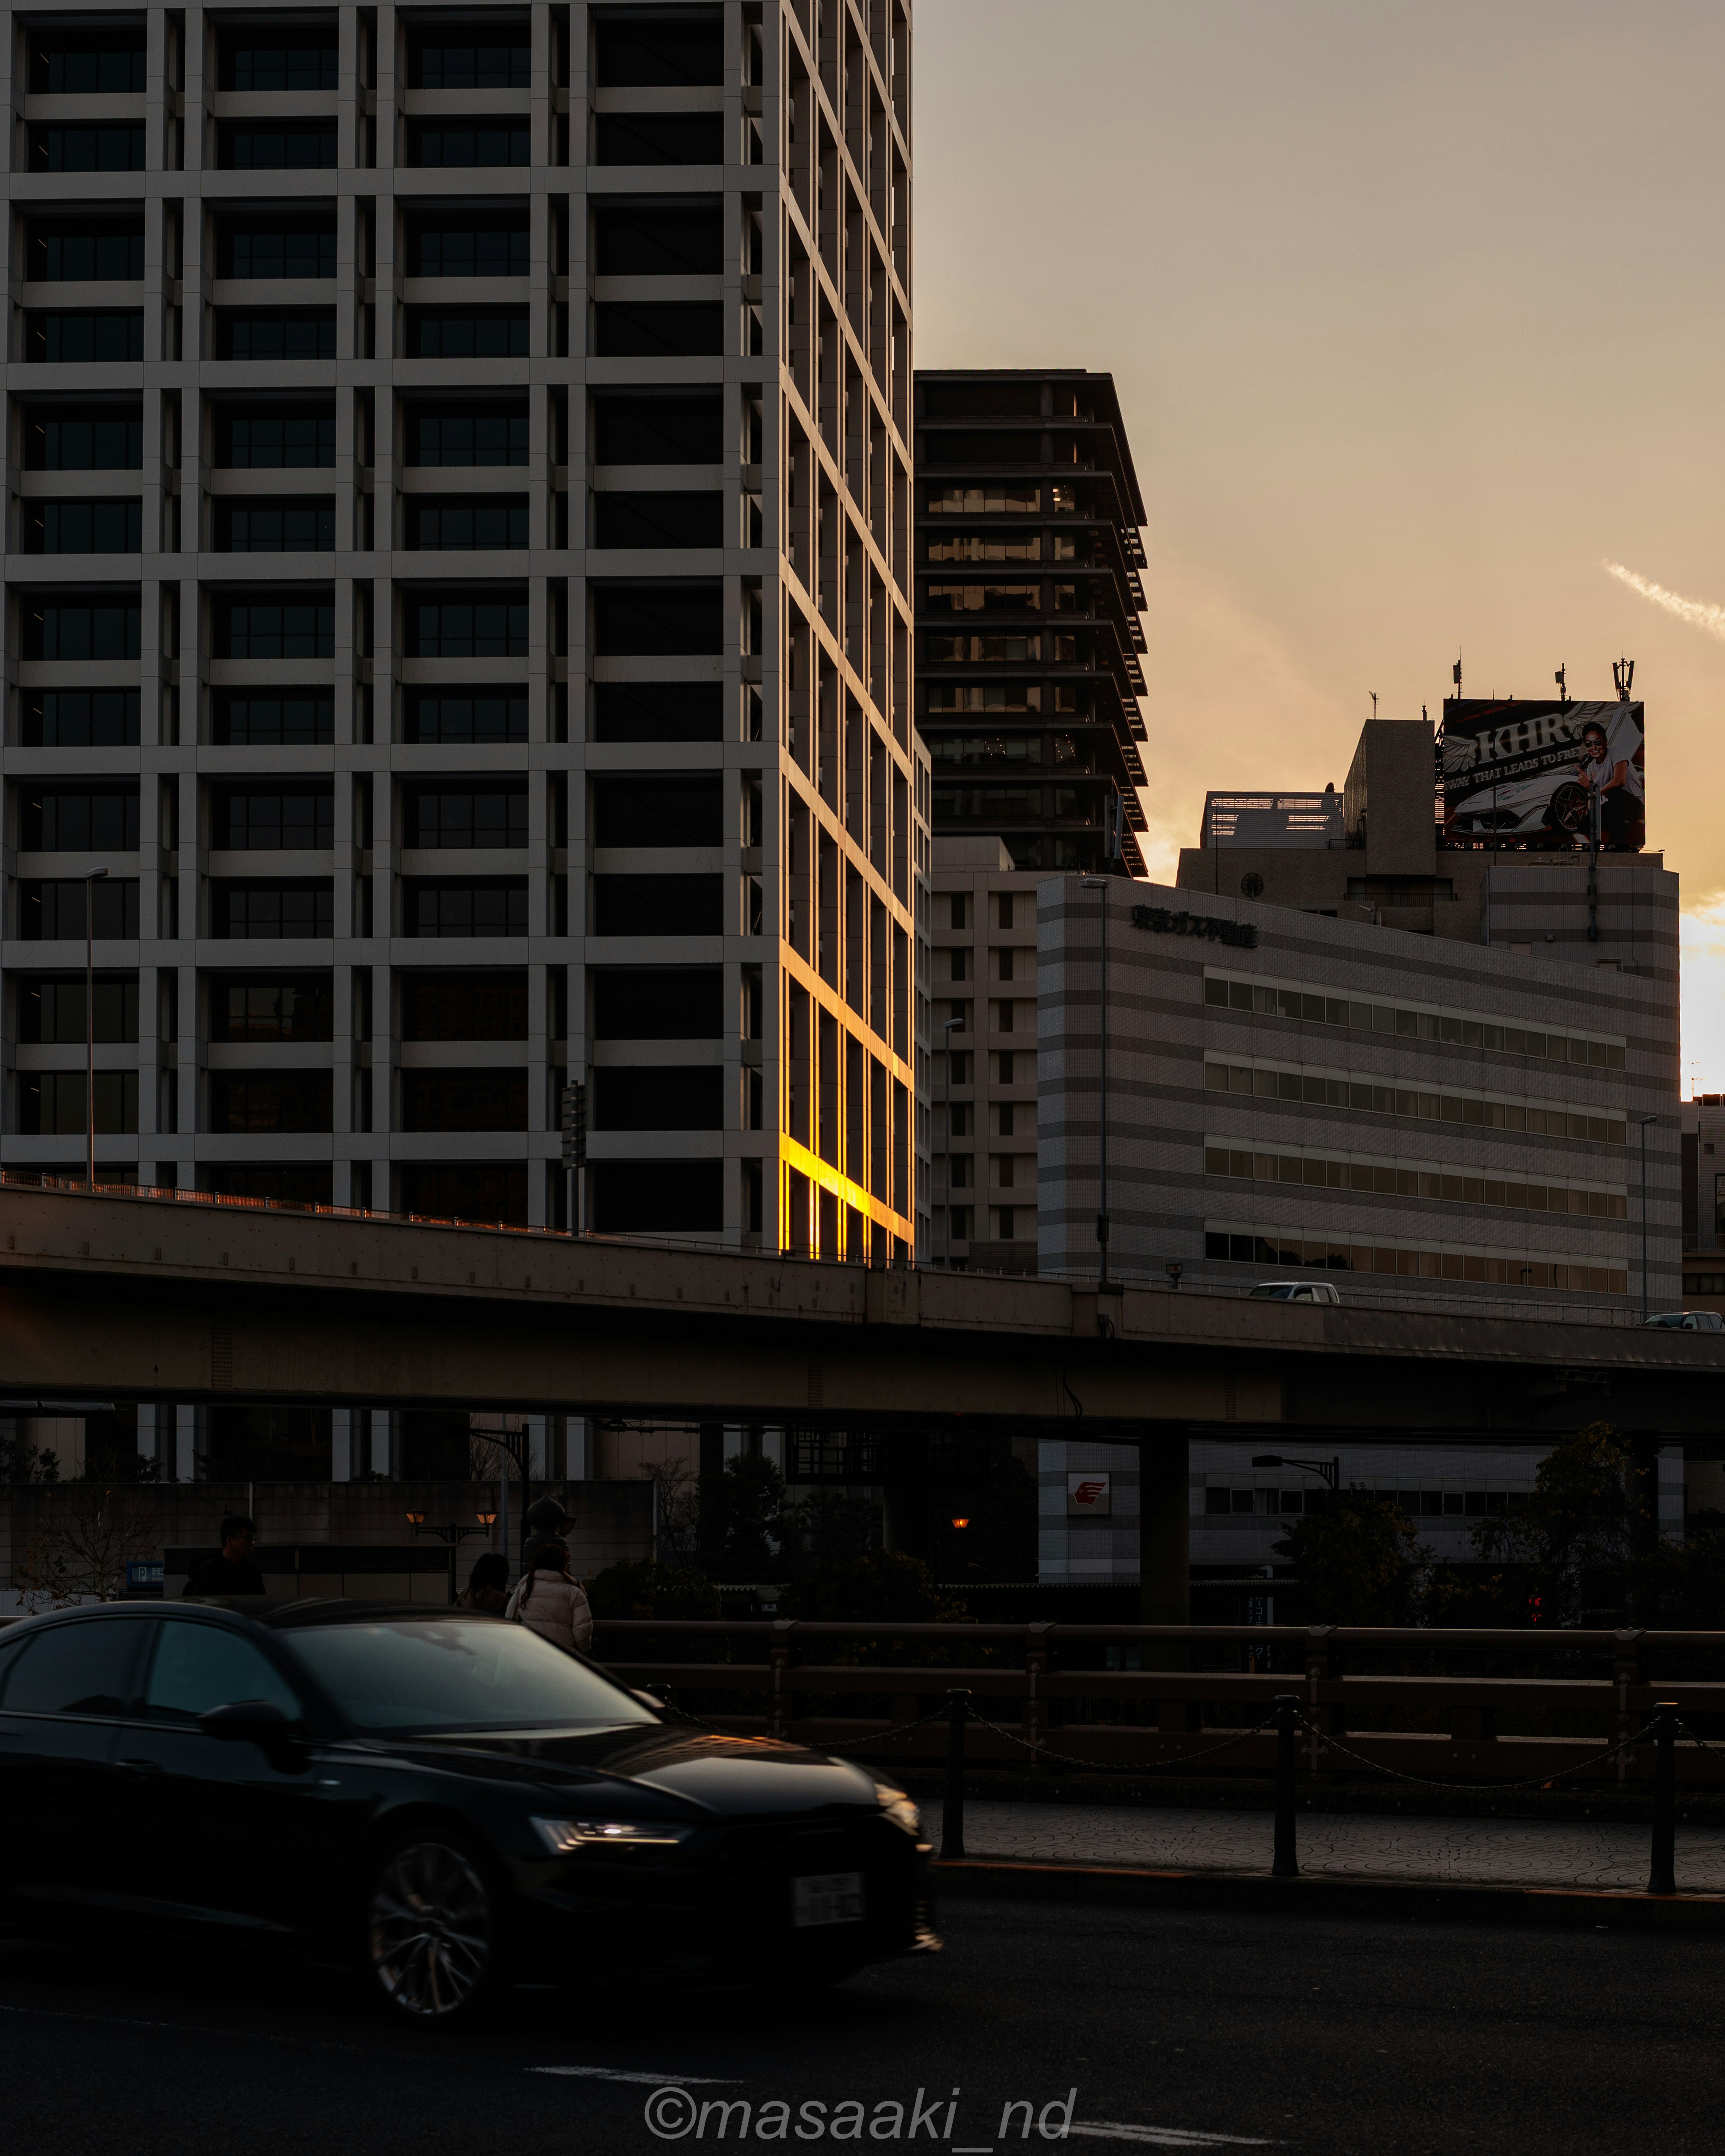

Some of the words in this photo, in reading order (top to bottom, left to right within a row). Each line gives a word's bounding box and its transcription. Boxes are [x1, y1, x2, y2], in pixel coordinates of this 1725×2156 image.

[1476, 713, 1571, 764] KHR
[1472, 767, 1502, 783] THAT
[1504, 758, 1539, 775] LEADS
[1540, 754, 1556, 765] TO
[1132, 904, 1258, 948] 東京ガス不動産
